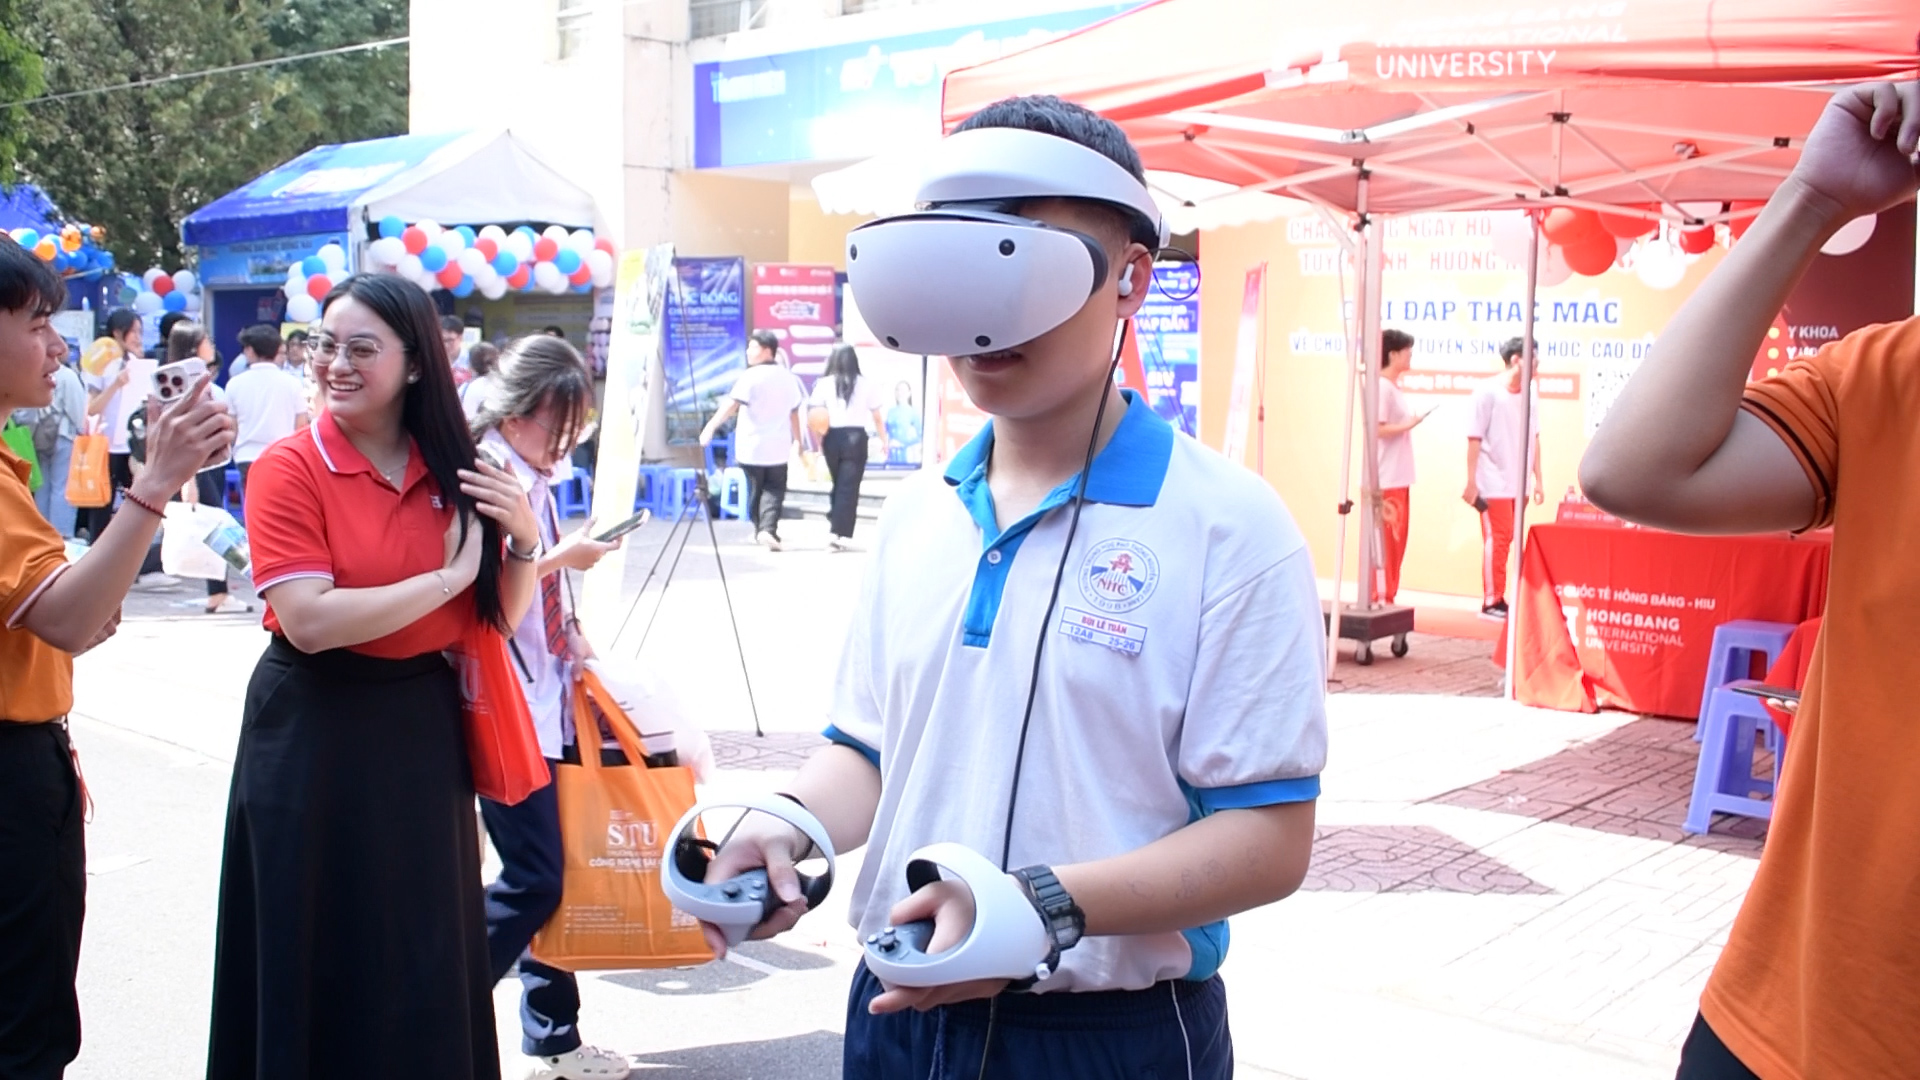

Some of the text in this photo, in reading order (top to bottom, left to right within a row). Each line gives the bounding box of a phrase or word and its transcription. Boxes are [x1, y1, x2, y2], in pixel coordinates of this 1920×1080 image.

[1375, 50, 1556, 79] UNIVERSITY
[1788, 325, 1840, 340] Y KHOA
[1592, 342, 1625, 359] CAO
[1694, 597, 1717, 610] HIU
[1586, 608, 1681, 632] HONGBANG
[1108, 636, 1136, 650] 25-26
[1586, 624, 1686, 648] INTERNATIONAL
[1585, 637, 1659, 657] UNIVERSITY
[608, 822, 658, 847] STU
